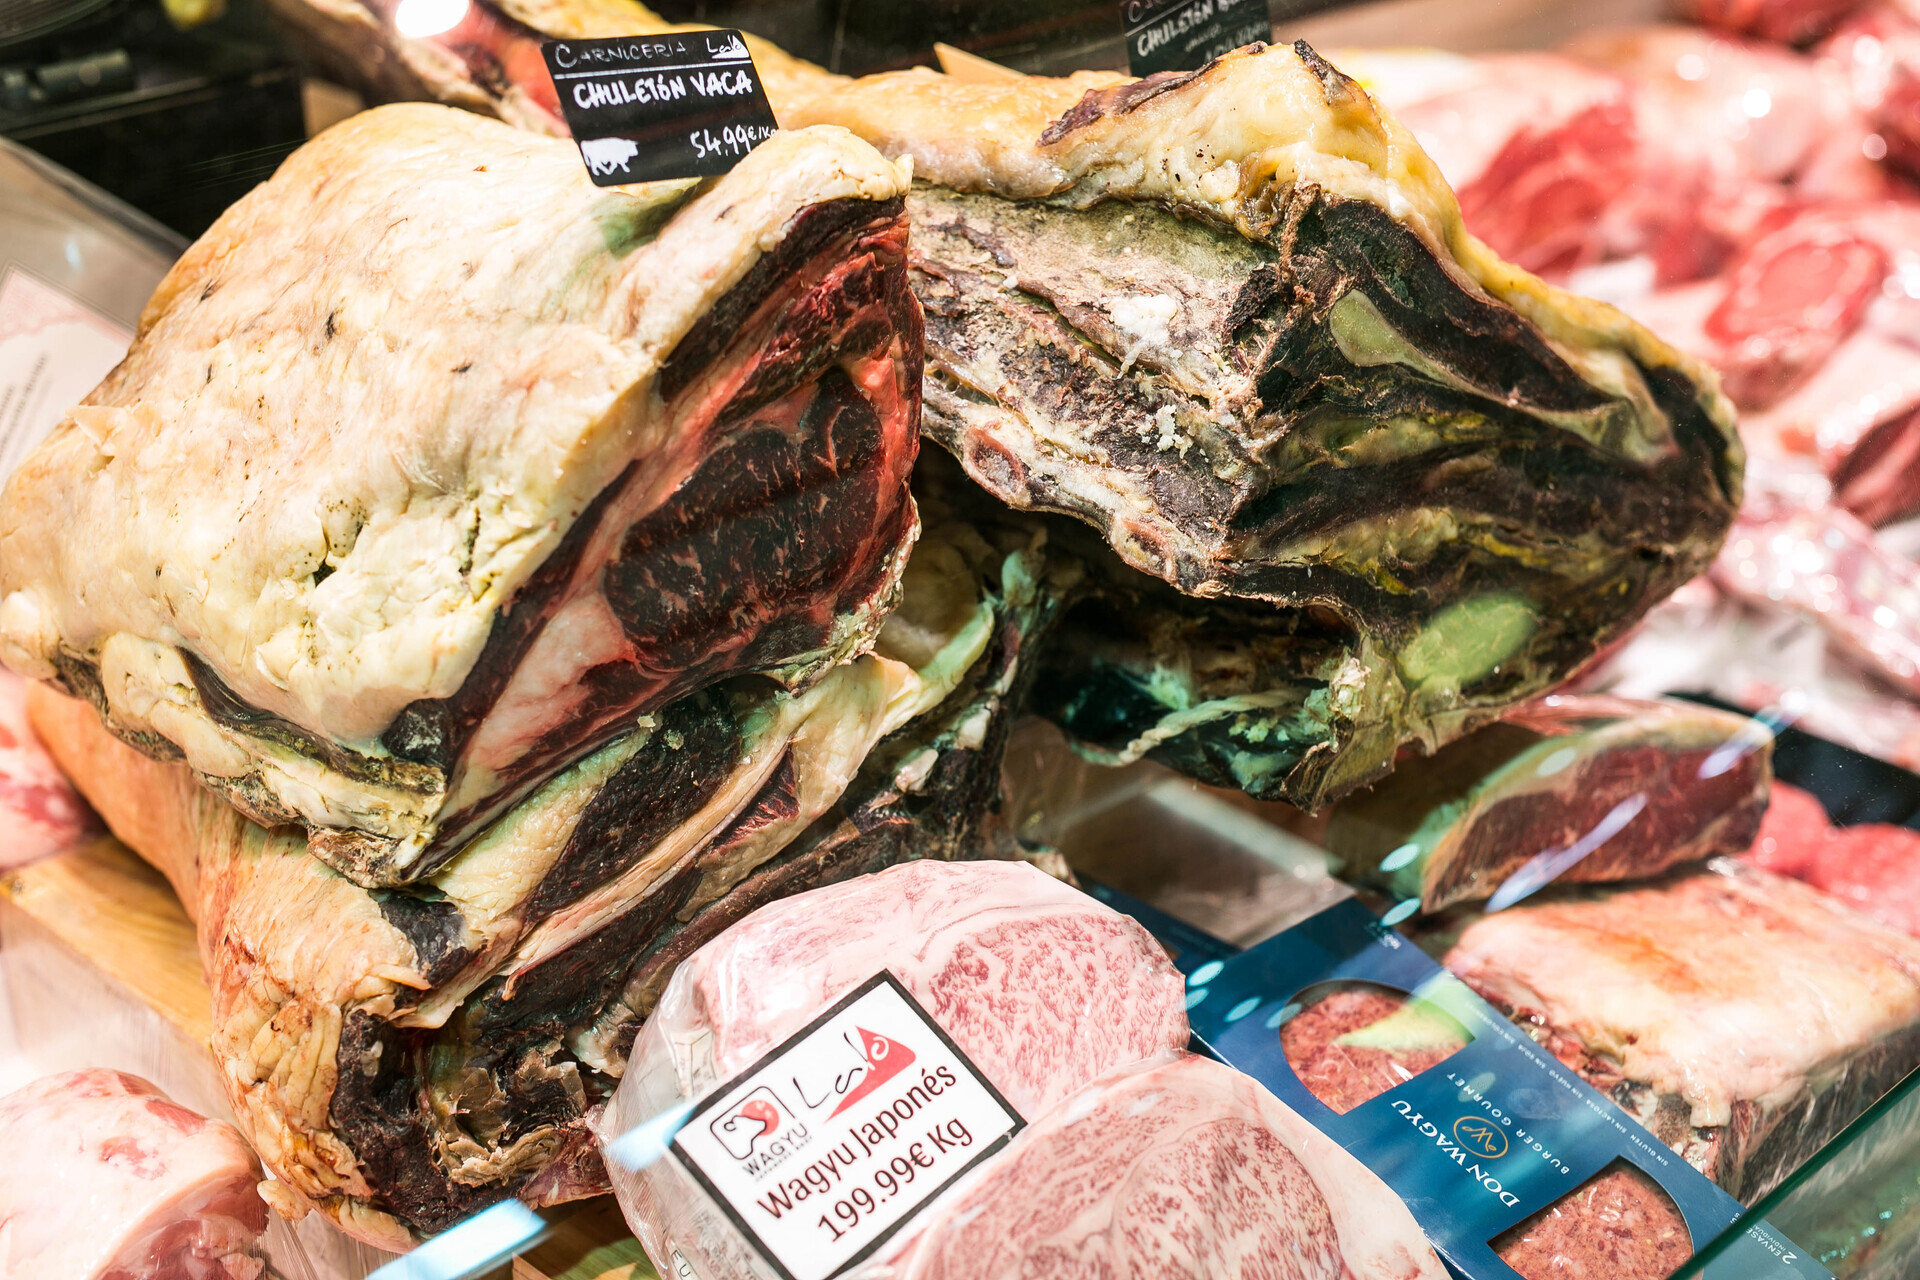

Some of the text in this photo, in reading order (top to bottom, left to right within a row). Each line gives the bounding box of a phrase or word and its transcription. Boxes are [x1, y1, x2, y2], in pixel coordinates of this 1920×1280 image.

[554, 41, 688, 68] CARNICERIA
[690, 69, 753, 97] VACA
[1446, 1072, 1570, 1175] BURGER GOURMET
[1585, 1098, 1616, 1128] LACTOSA
[1614, 1121, 1628, 1134] SIN
[742, 1122, 808, 1176] WAGYU
[757, 1142, 857, 1219] Wagyu
[849, 1065, 957, 1157] Japonés
[1391, 1100, 1520, 1208] DON WAGYU
[1630, 1134, 1657, 1160] GLUTEN
[1656, 1154, 1669, 1167] SIN
[817, 1142, 935, 1242] 199.99€
[926, 1118, 973, 1154] Kg
[1780, 1250, 1798, 1265] 2
